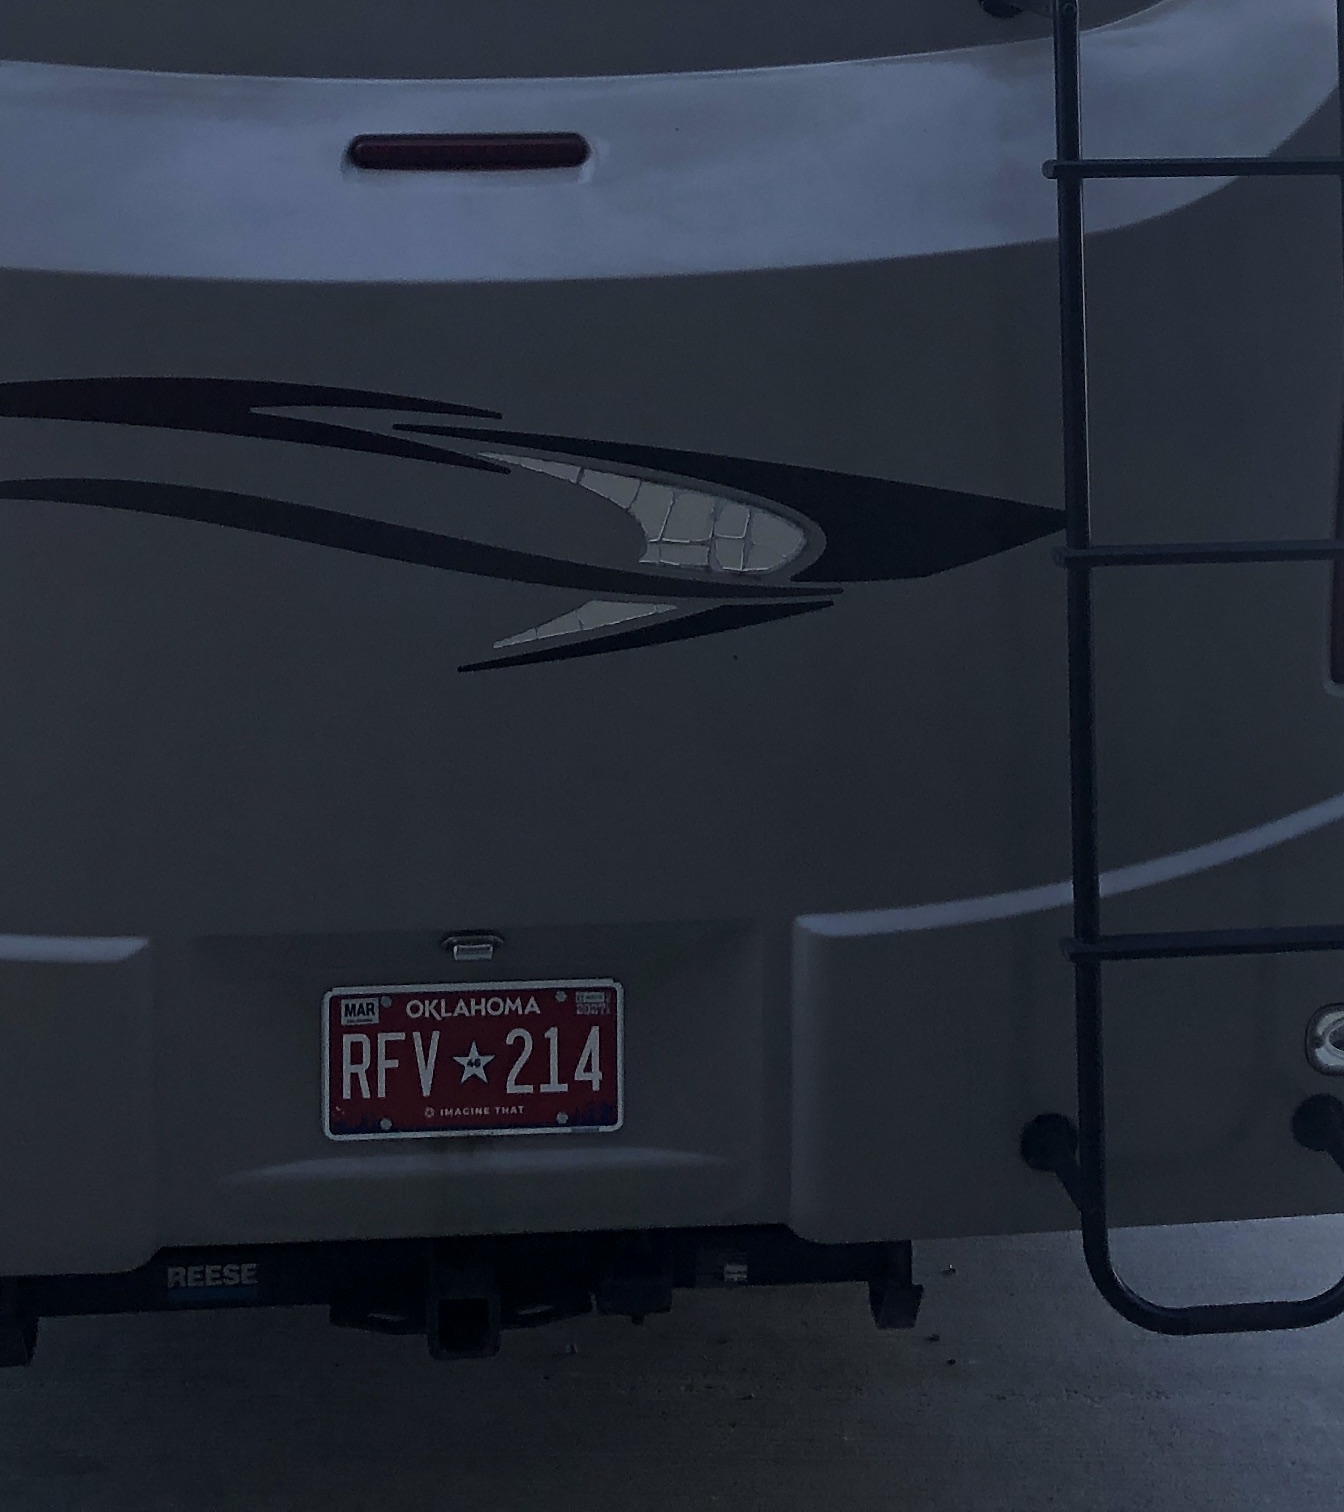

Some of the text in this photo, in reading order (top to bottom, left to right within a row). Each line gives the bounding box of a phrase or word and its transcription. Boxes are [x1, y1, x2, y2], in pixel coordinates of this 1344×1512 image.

[344, 1002, 375, 1017] MAR
[406, 996, 541, 1021] OKLAHOMA
[341, 1025, 602, 1100] RFV 214
[439, 1105, 525, 1117] IMAGINE THAT
[167, 1263, 259, 1288] REESE
